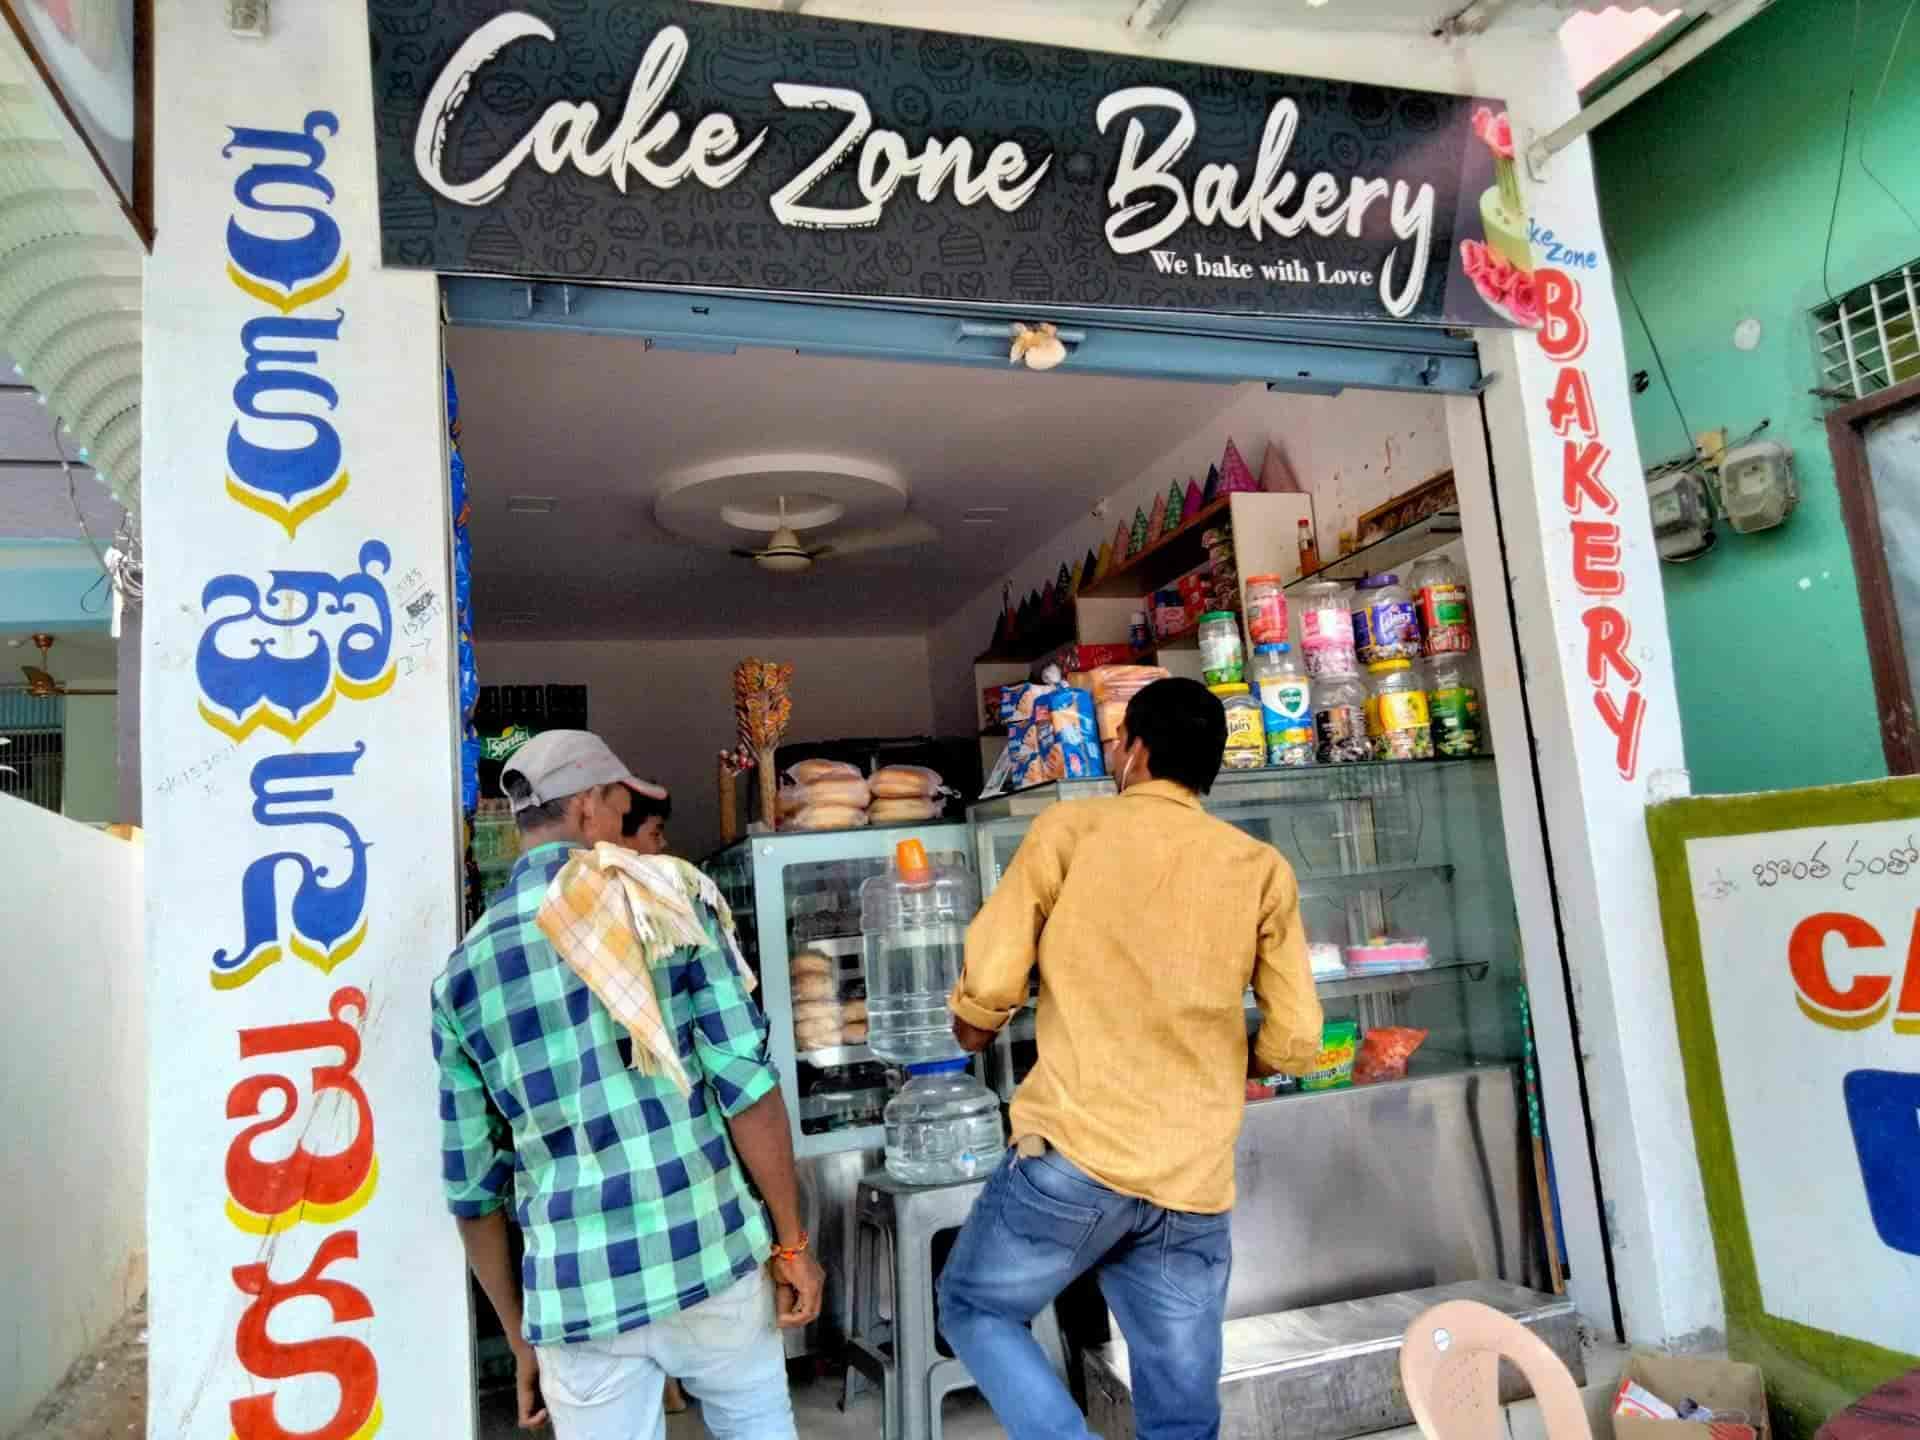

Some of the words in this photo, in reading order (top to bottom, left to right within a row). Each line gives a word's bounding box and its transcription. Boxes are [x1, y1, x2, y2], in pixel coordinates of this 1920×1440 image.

[413, 11, 769, 206] Cake
[769, 82, 1054, 229] Zone
[1096, 86, 1435, 318] Bakery
[1149, 249, 1188, 275] We
[1194, 252, 1254, 279] bake
[1260, 259, 1311, 283] with
[1316, 260, 1374, 286] Love
[1535, 267, 1648, 780] BAKERY
[1787, 911, 1920, 1032] C
